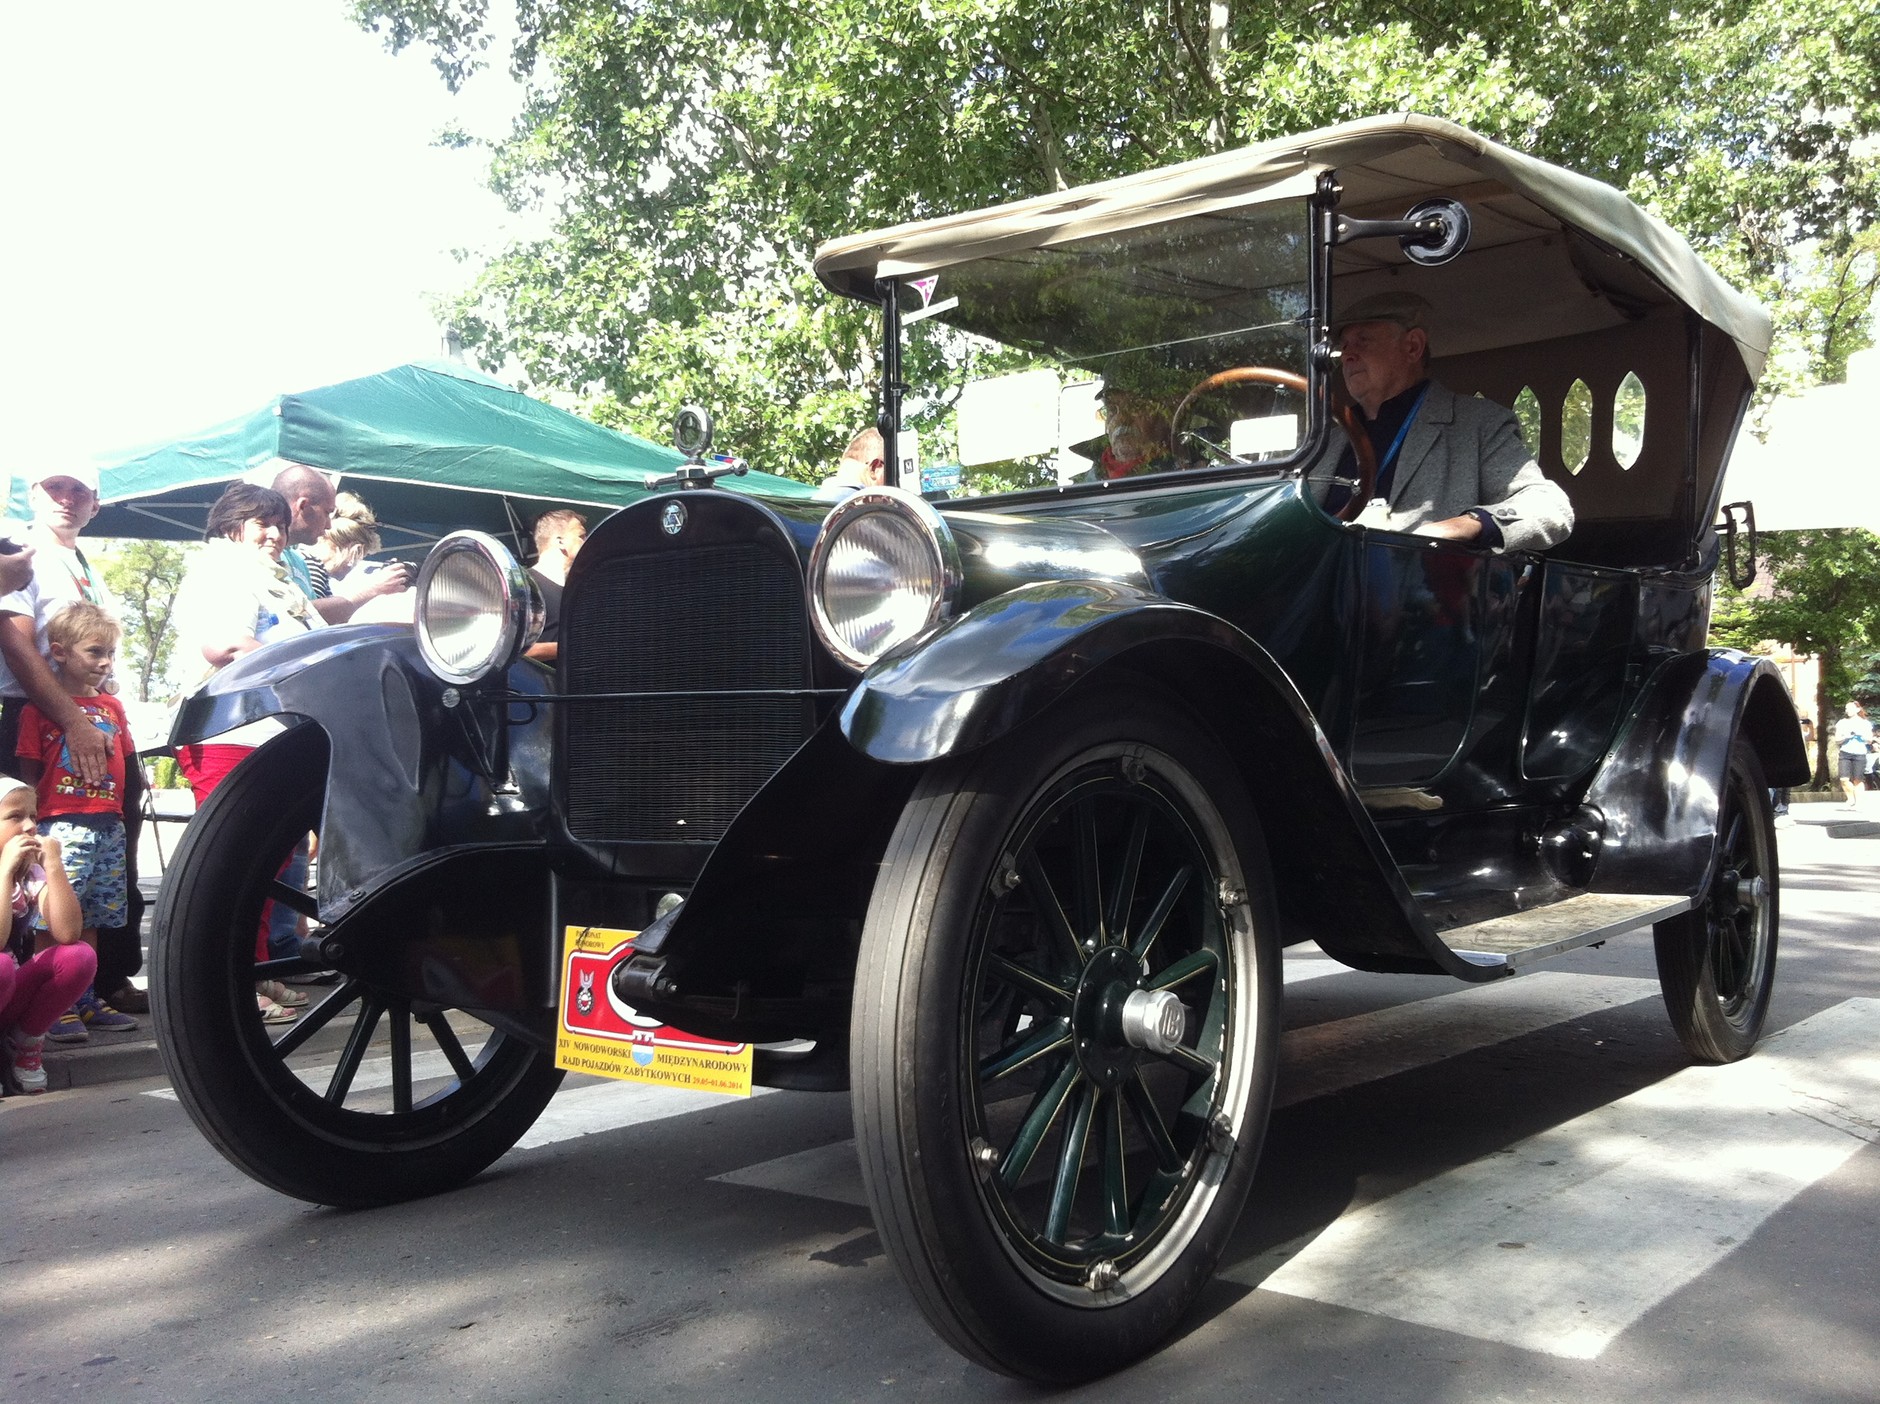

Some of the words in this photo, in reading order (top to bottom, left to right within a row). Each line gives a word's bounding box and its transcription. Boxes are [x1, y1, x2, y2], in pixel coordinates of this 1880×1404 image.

[558, 1038, 571, 1049] XIV
[573, 1041, 631, 1059] NOWODWORSKI
[657, 1053, 749, 1073] MIĘDZYNARODOWY
[562, 1055, 581, 1066] RAJD
[581, 1057, 622, 1073] POJAZDÓW
[623, 1065, 691, 1084] ZABYTKOWYCH
